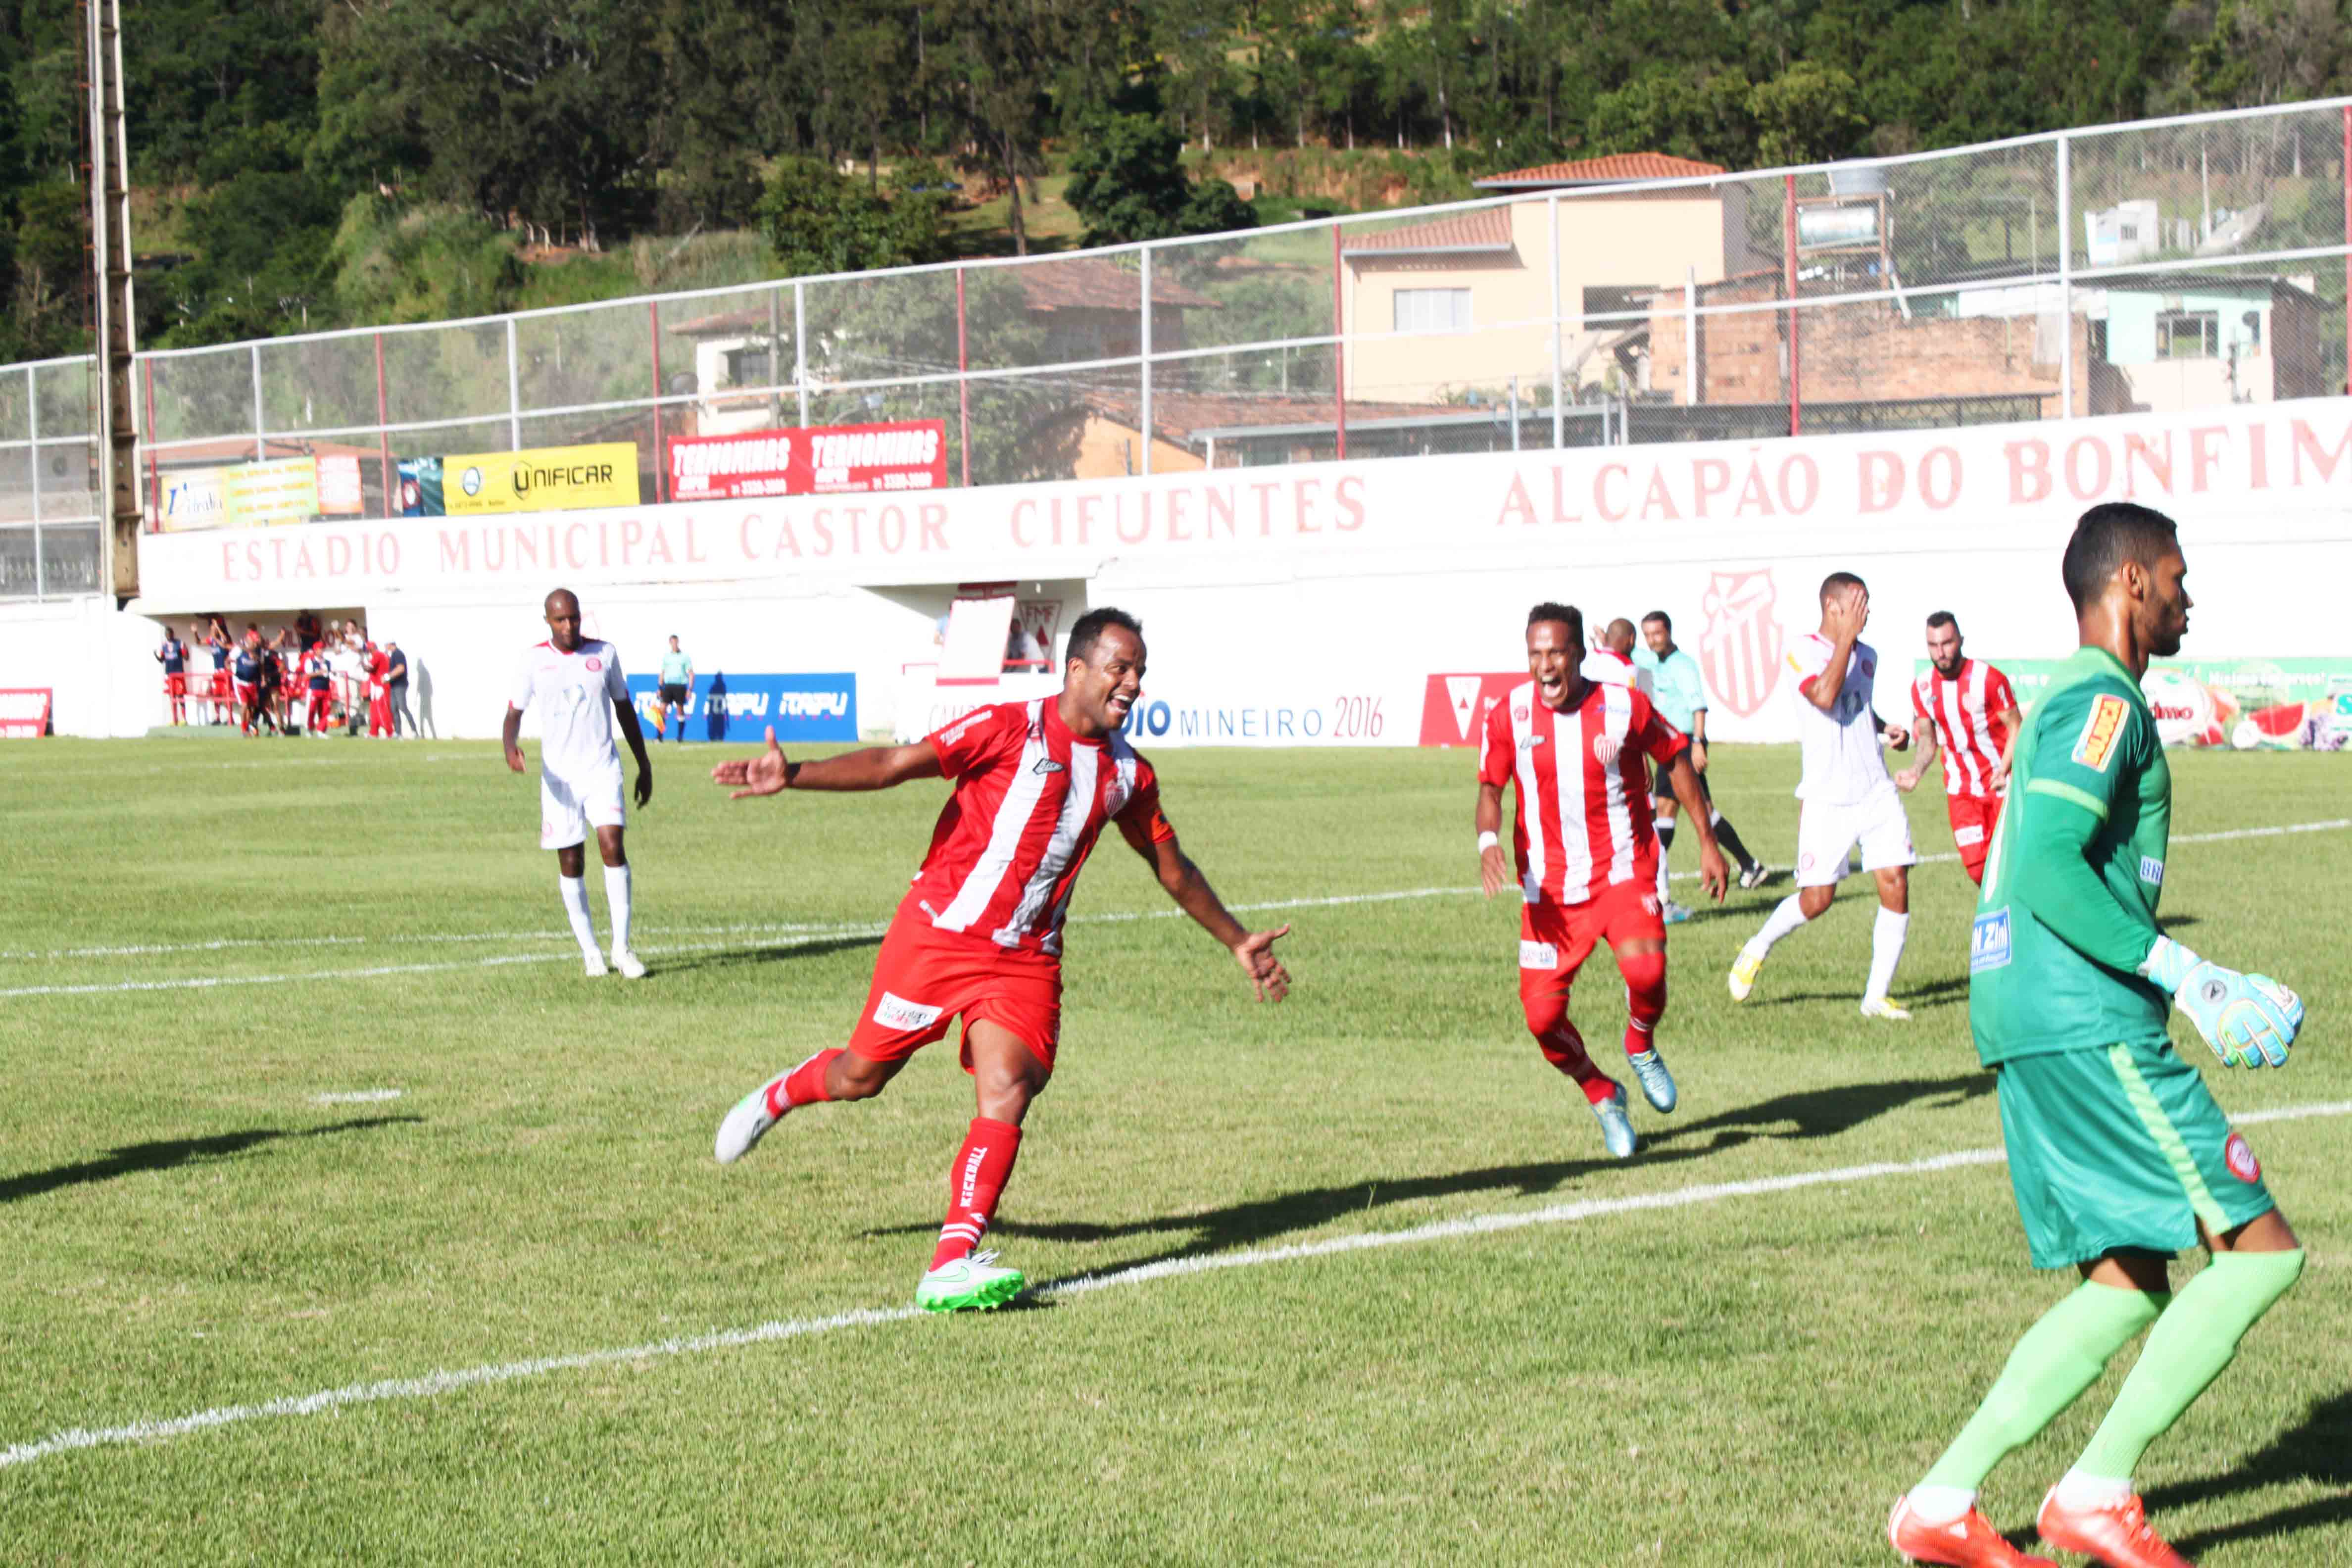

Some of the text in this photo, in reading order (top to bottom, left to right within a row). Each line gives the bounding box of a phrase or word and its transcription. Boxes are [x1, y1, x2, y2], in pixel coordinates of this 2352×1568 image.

[513, 464, 613, 492] UNIFICAR
[1856, 445, 1964, 515] DO
[2003, 418, 2352, 506] BONFIM
[438, 516, 707, 572] MUNICIPAL
[739, 502, 951, 561] CASTOR
[1010, 475, 1366, 548] CIFUENTES
[1180, 709, 1322, 737] MINEIRO
[1332, 696, 1384, 737] 2016
[959, 1147, 988, 1207] KICKBALL
